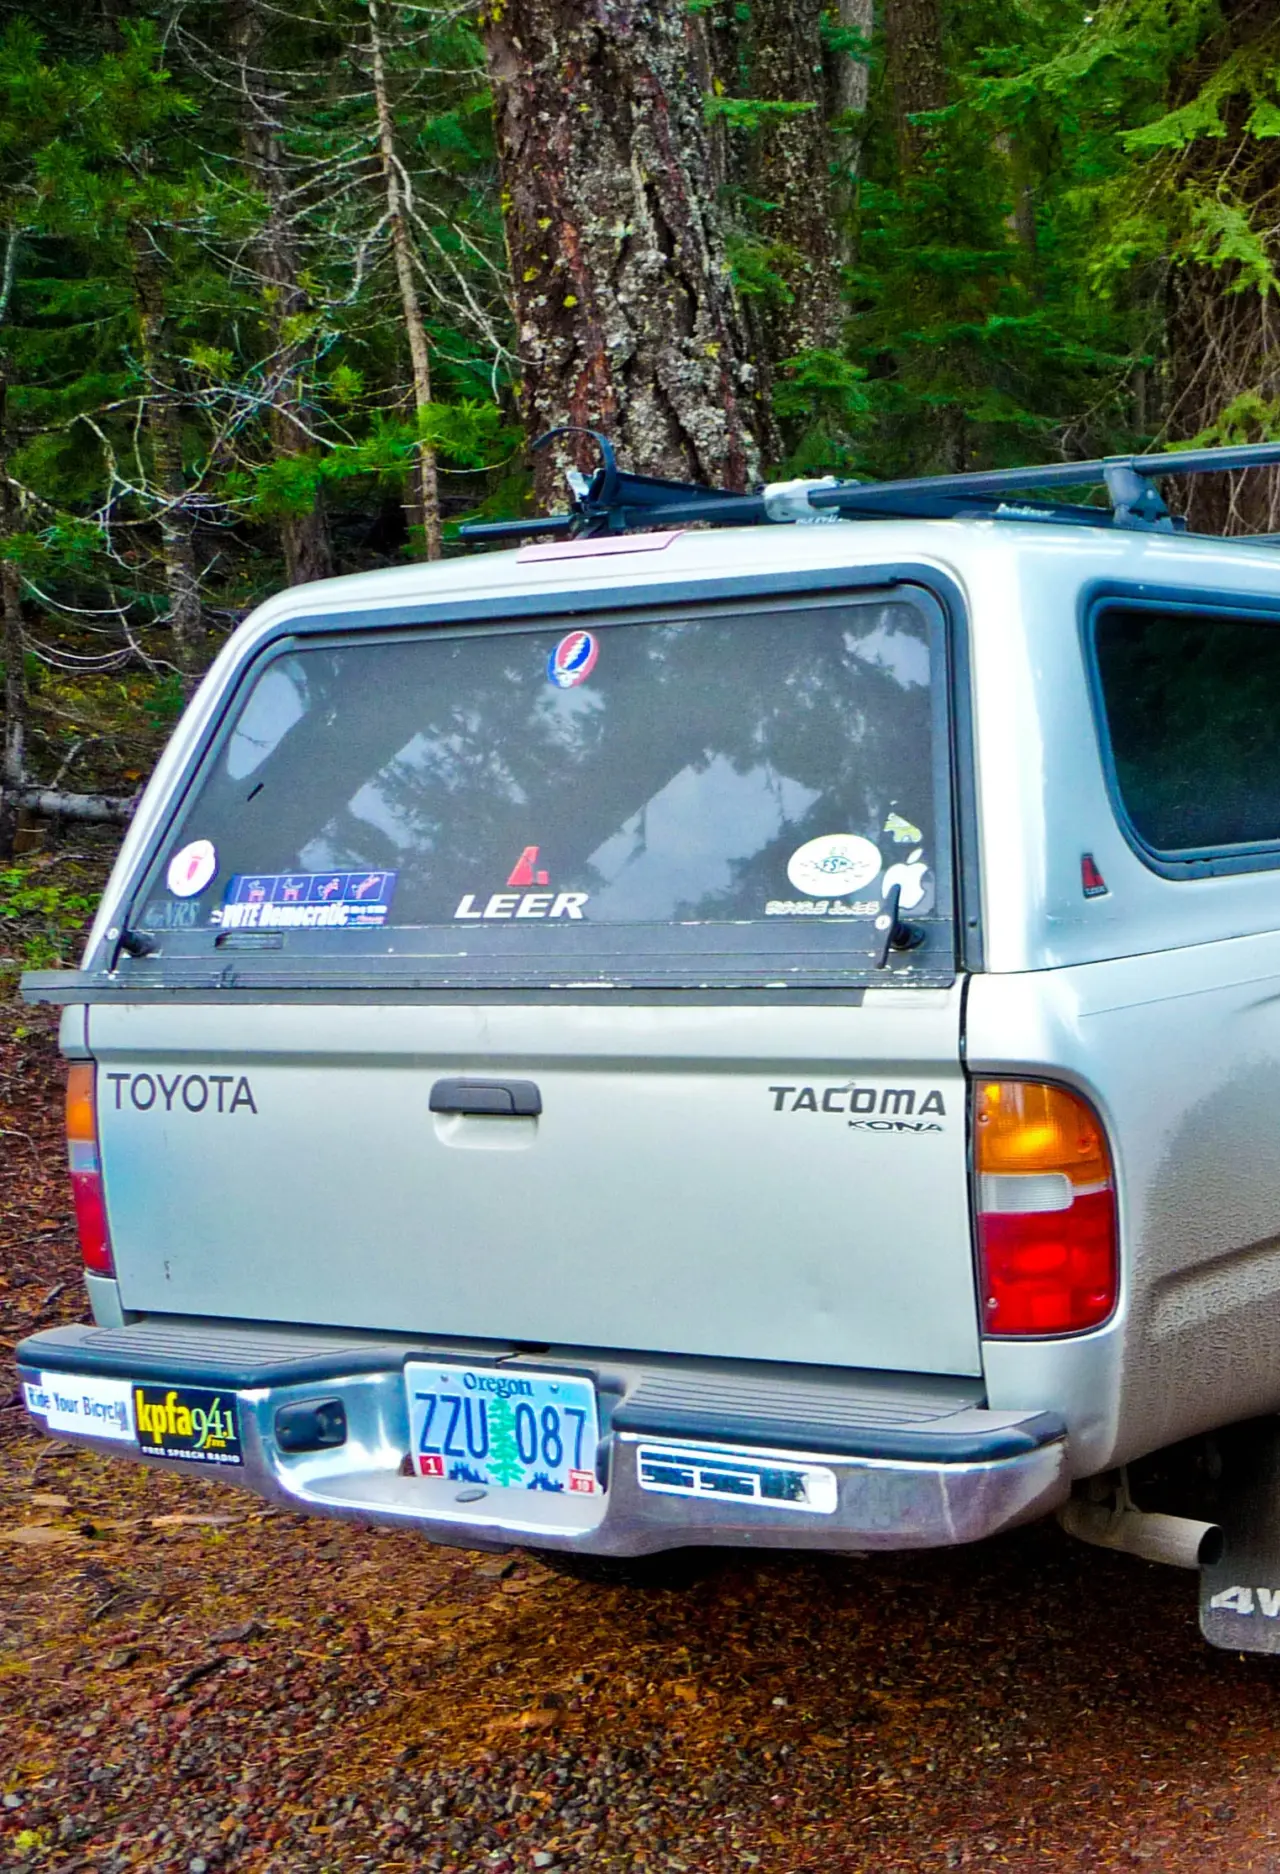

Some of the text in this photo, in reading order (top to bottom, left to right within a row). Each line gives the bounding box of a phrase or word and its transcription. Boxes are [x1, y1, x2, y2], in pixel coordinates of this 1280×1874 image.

[453, 892, 589, 919] LEER
[106, 1073, 258, 1114] TOYOTA
[768, 1086, 946, 1116] TACOMA
[847, 1119, 943, 1132] KONA
[463, 1372, 533, 1399] Oregon
[52, 1392, 79, 1413] Your
[135, 1389, 193, 1444] kpfa
[415, 1392, 586, 1468] ZZU 087
[142, 1446, 240, 1463] FREE SPEECH RADIO
